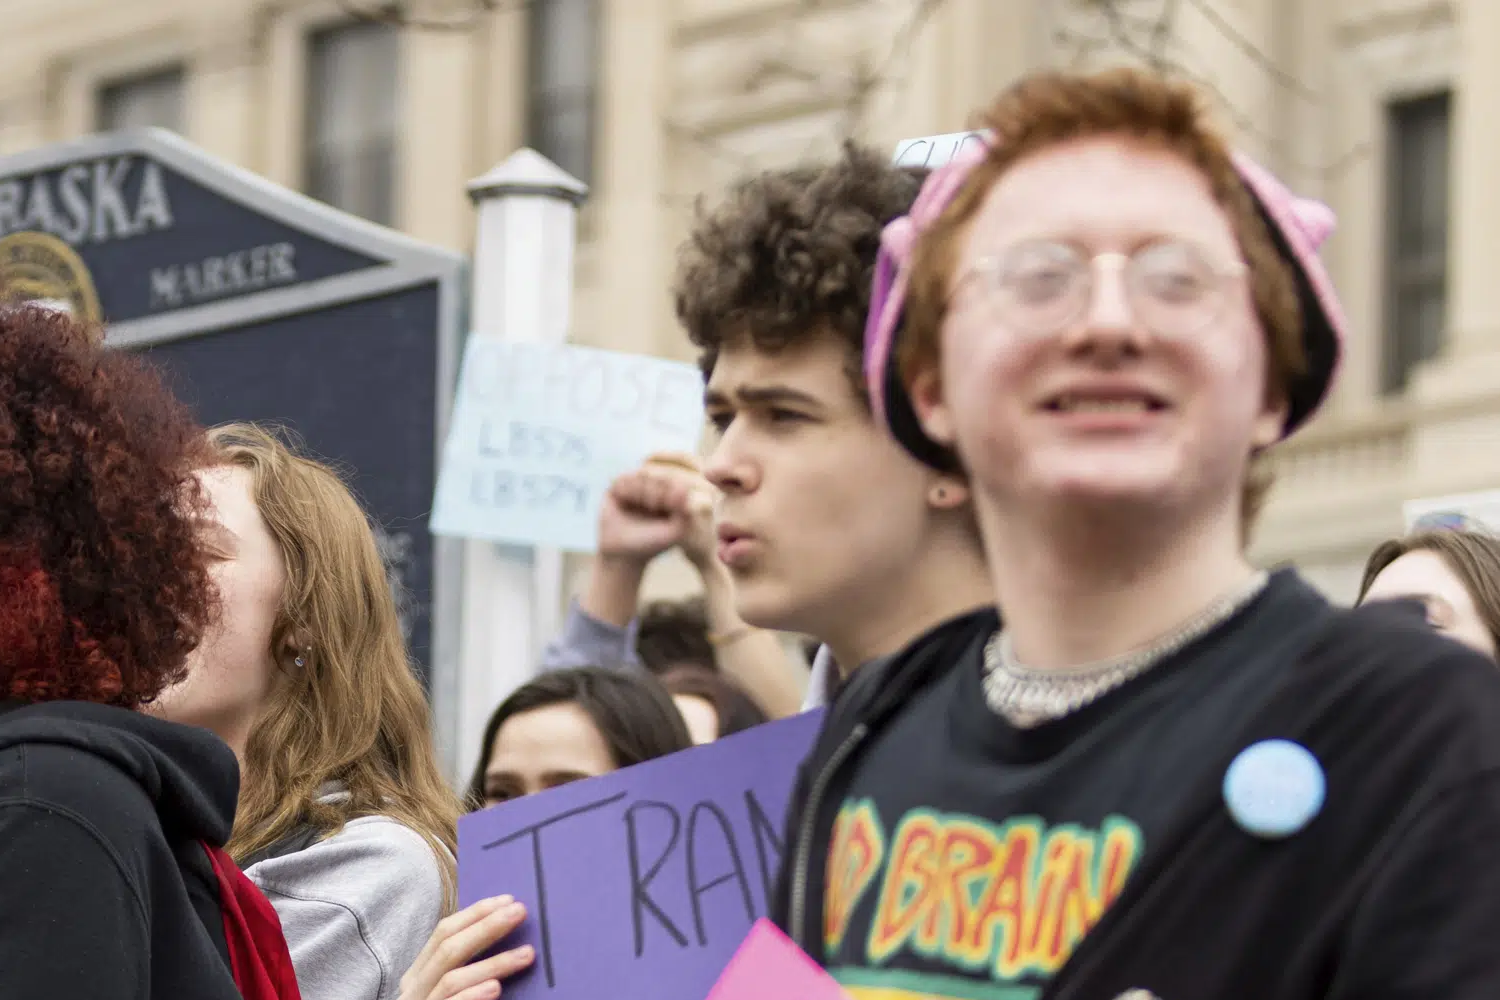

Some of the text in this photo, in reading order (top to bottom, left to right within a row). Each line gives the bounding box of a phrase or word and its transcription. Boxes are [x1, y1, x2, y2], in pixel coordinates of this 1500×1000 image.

[150, 242, 297, 306] MARKER
[482, 788, 786, 989] TRAN
[866, 804, 1145, 982] BRAIN
